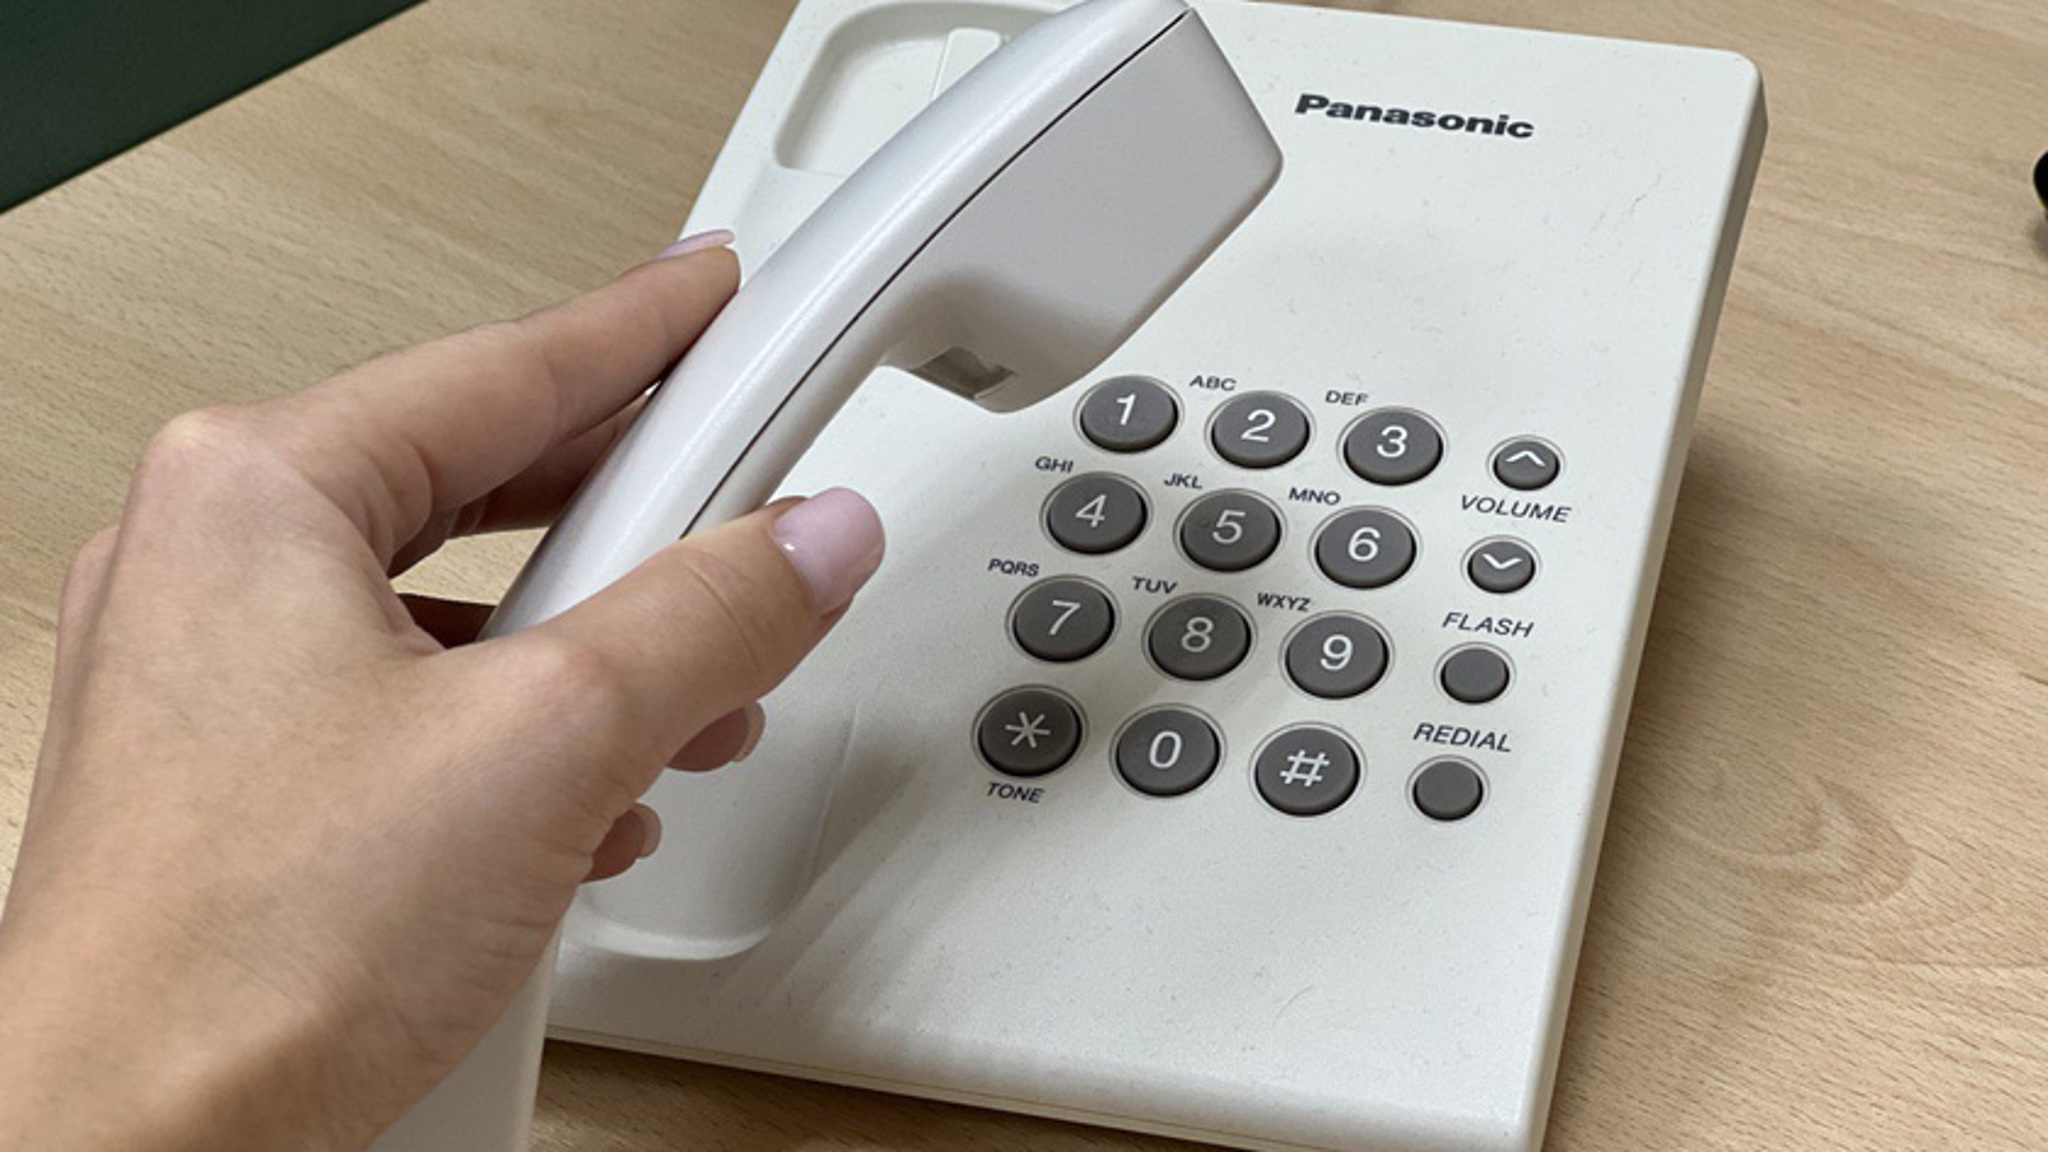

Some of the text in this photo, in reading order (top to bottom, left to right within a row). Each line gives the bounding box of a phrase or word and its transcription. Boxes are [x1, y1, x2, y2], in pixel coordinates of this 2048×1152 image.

[1294, 93, 1534, 139] Panasonic
[1189, 375, 1237, 391] ABC
[1325, 390, 1369, 407] DEF
[1115, 392, 1138, 426] 1
[1241, 409, 1276, 442] 2
[1376, 425, 1408, 458] 3
[1035, 456, 1074, 473] GHI
[1163, 473, 1202, 489] JKL
[1288, 487, 1341, 506] MNO
[1075, 494, 1106, 528] 4
[1461, 494, 1572, 523] VOLUME
[1212, 509, 1246, 543] 5
[1348, 526, 1381, 562] 6
[987, 558, 1040, 577] PQRS
[1133, 576, 1178, 595] TUV
[1049, 599, 1081, 635] 7
[1257, 592, 1310, 611] WXYZ
[1181, 616, 1214, 653] 8
[1442, 611, 1534, 638] FLASH
[1320, 634, 1353, 670] 9
[1149, 731, 1182, 769] 0
[1412, 722, 1511, 753] REDIAL
[987, 782, 1043, 803] TONE
